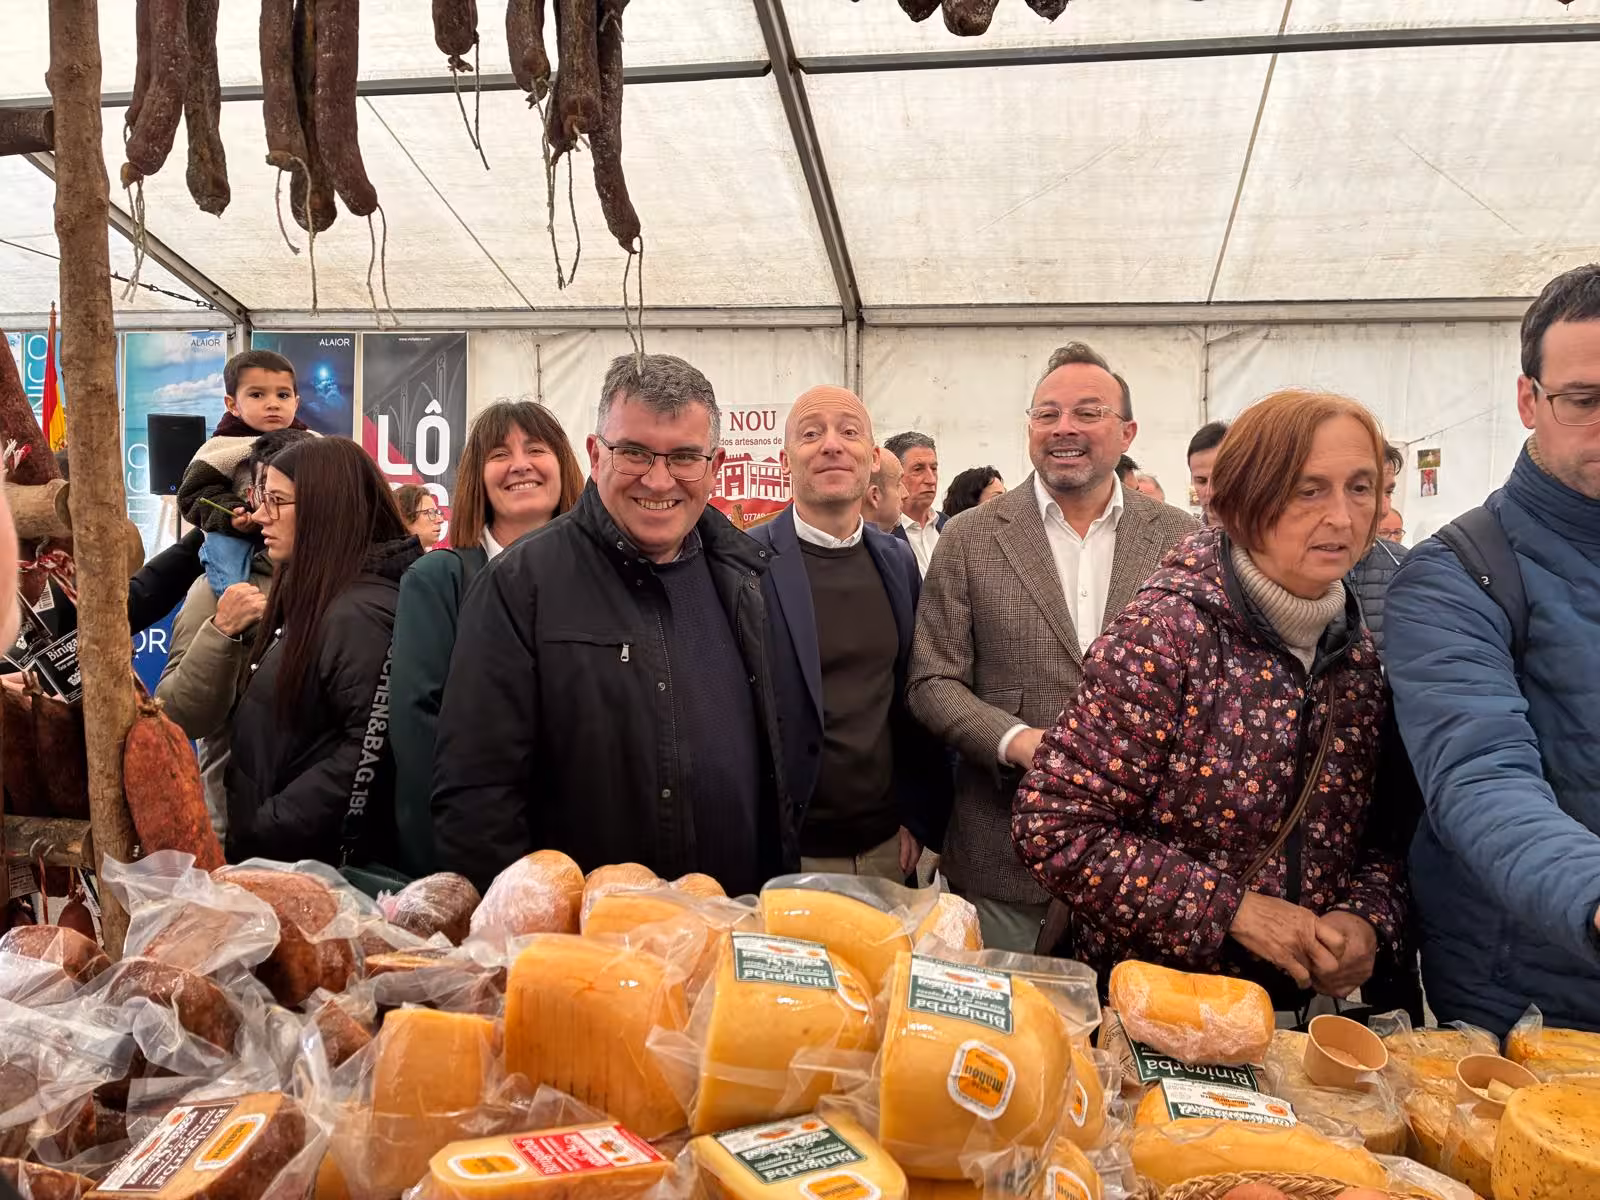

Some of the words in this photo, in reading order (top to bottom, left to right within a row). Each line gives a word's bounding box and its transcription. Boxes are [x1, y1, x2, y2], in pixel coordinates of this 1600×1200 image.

[191, 338, 221, 347] ALAIOR
[319, 338, 350, 347] ALAIOR
[729, 410, 777, 431] NOU
[377, 399, 450, 476] LÔ
[734, 437, 772, 446] artesanos
[773, 436, 783, 445] de
[127, 443, 149, 526] TICO
[915, 998, 1006, 1030] Binigarba
